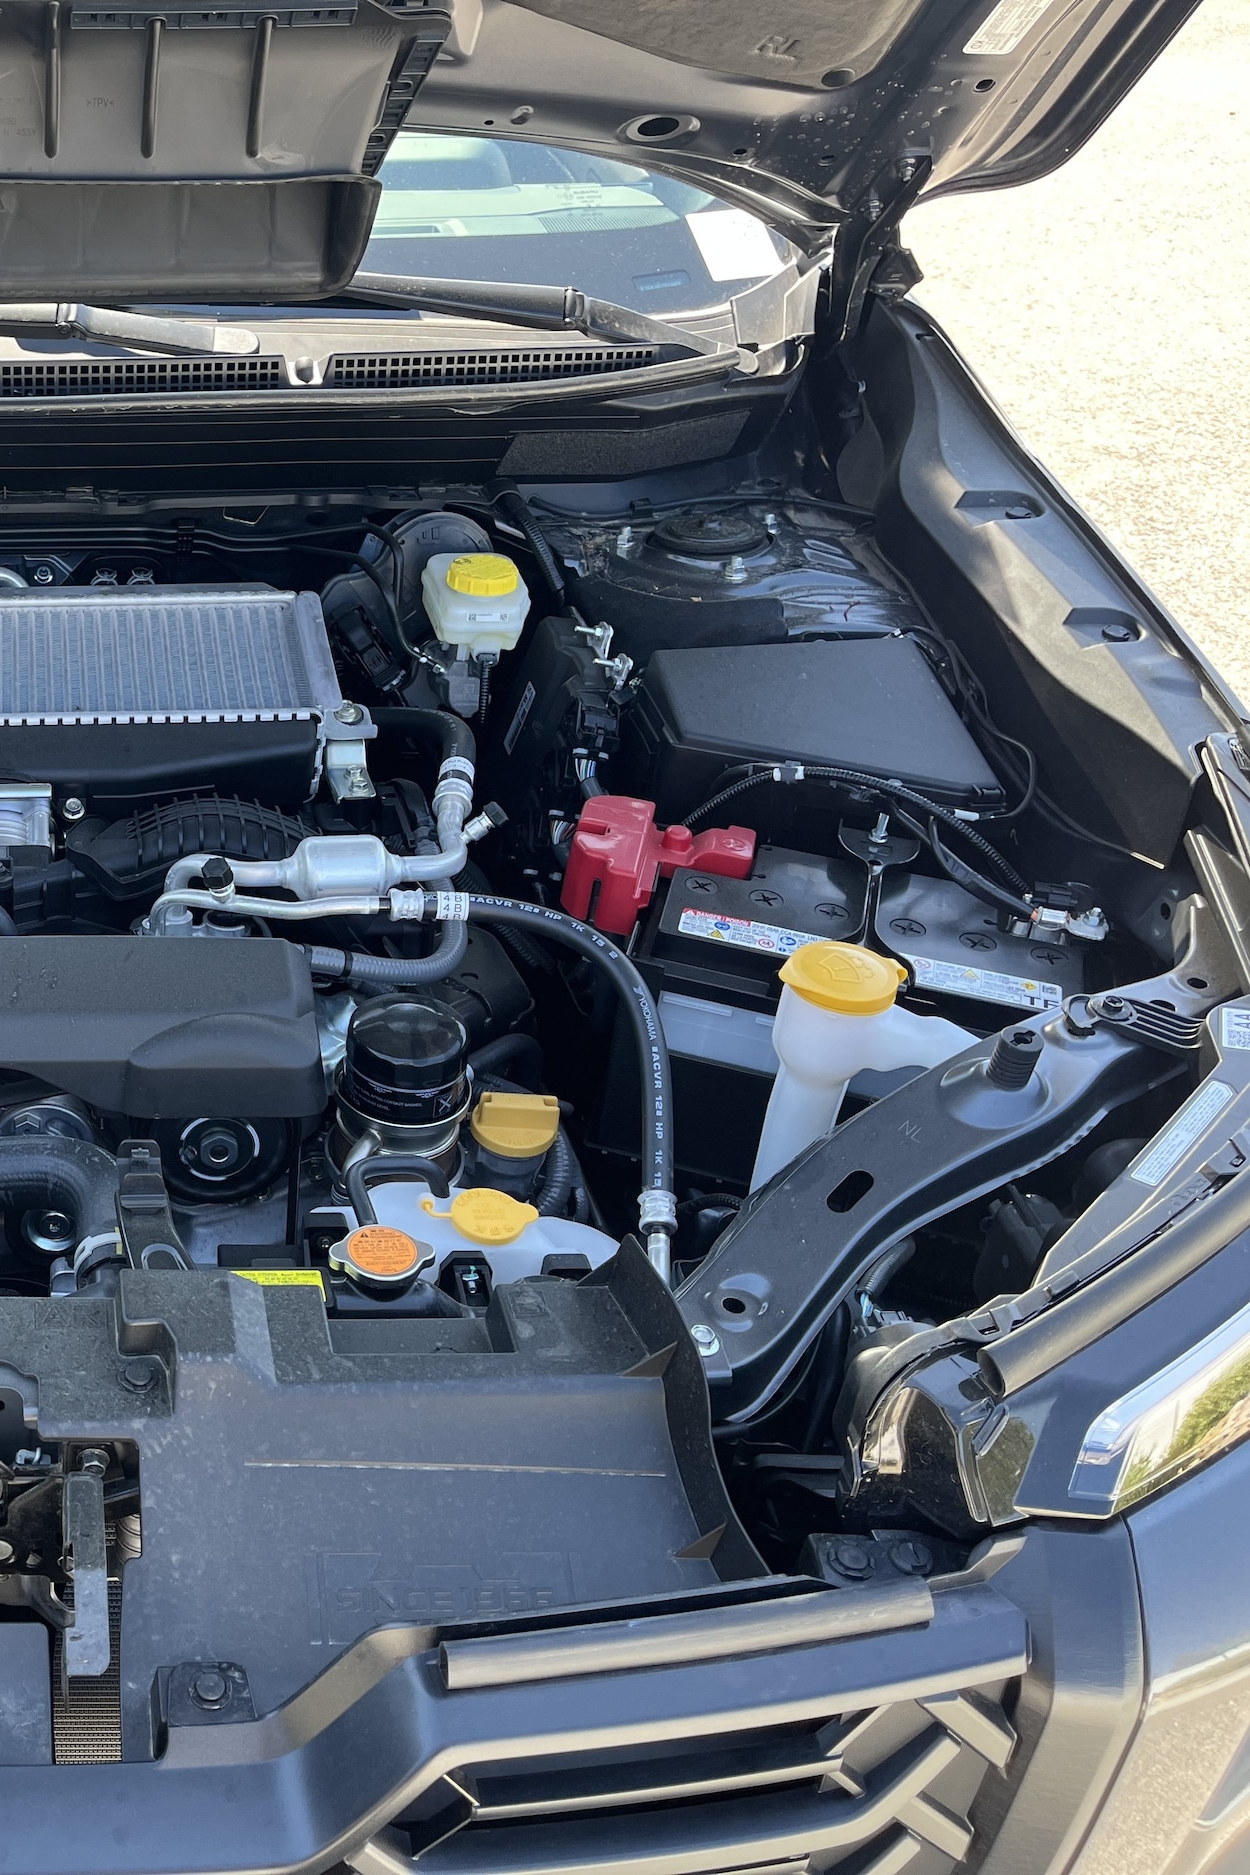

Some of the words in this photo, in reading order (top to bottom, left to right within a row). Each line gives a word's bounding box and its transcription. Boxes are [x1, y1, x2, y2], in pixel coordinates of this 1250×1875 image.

[544, 911, 562, 921] HP
[638, 995, 657, 1041] YOKOHAMA
[655, 1122, 664, 1139] HP
[897, 1119, 922, 1144] NL
[336, 1586, 455, 1613] SINCE
